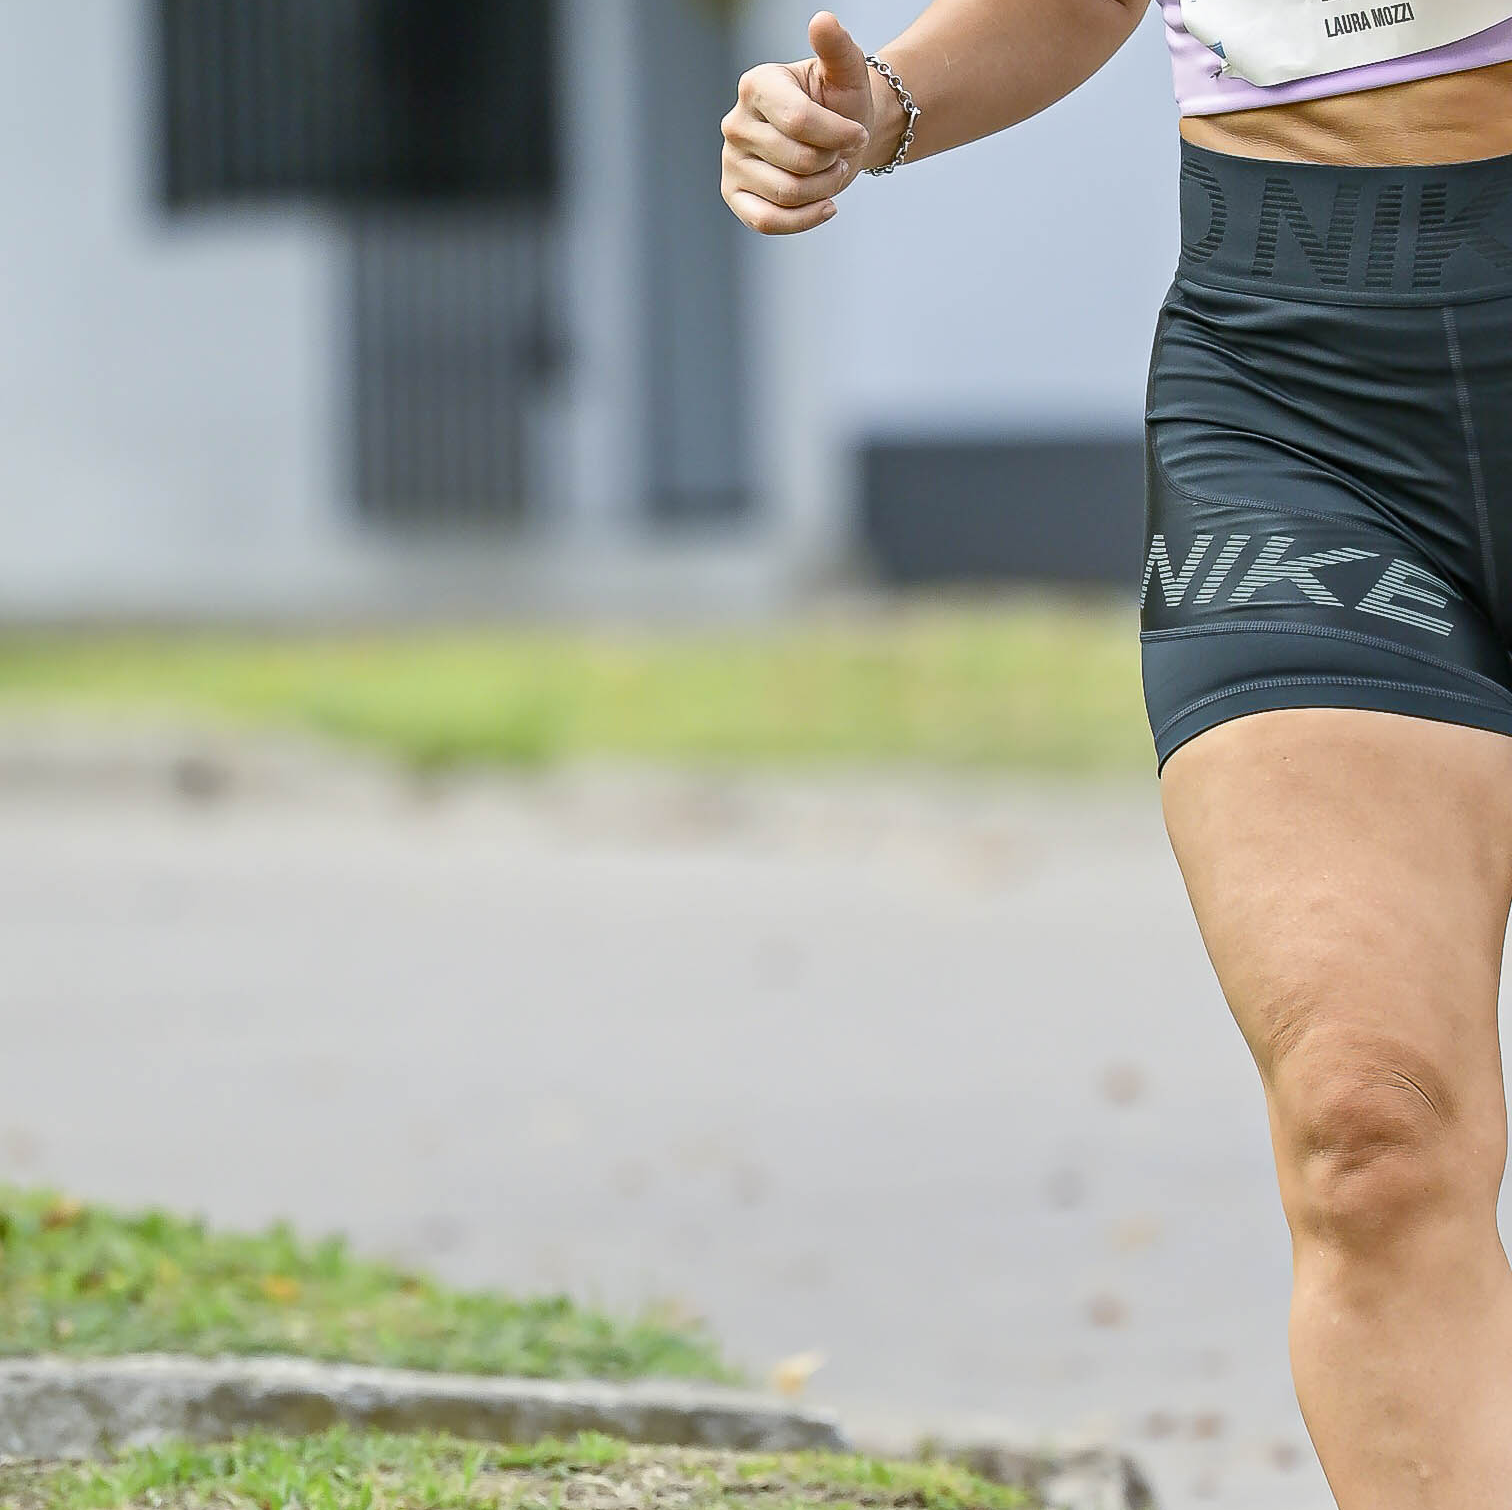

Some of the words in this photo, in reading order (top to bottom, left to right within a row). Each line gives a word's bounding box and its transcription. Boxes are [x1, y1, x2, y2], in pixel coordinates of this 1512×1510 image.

[1324, 10, 1371, 38] LAURA
[1371, 2, 1415, 28] MOZZI
[1140, 534, 1461, 637] NIKE
